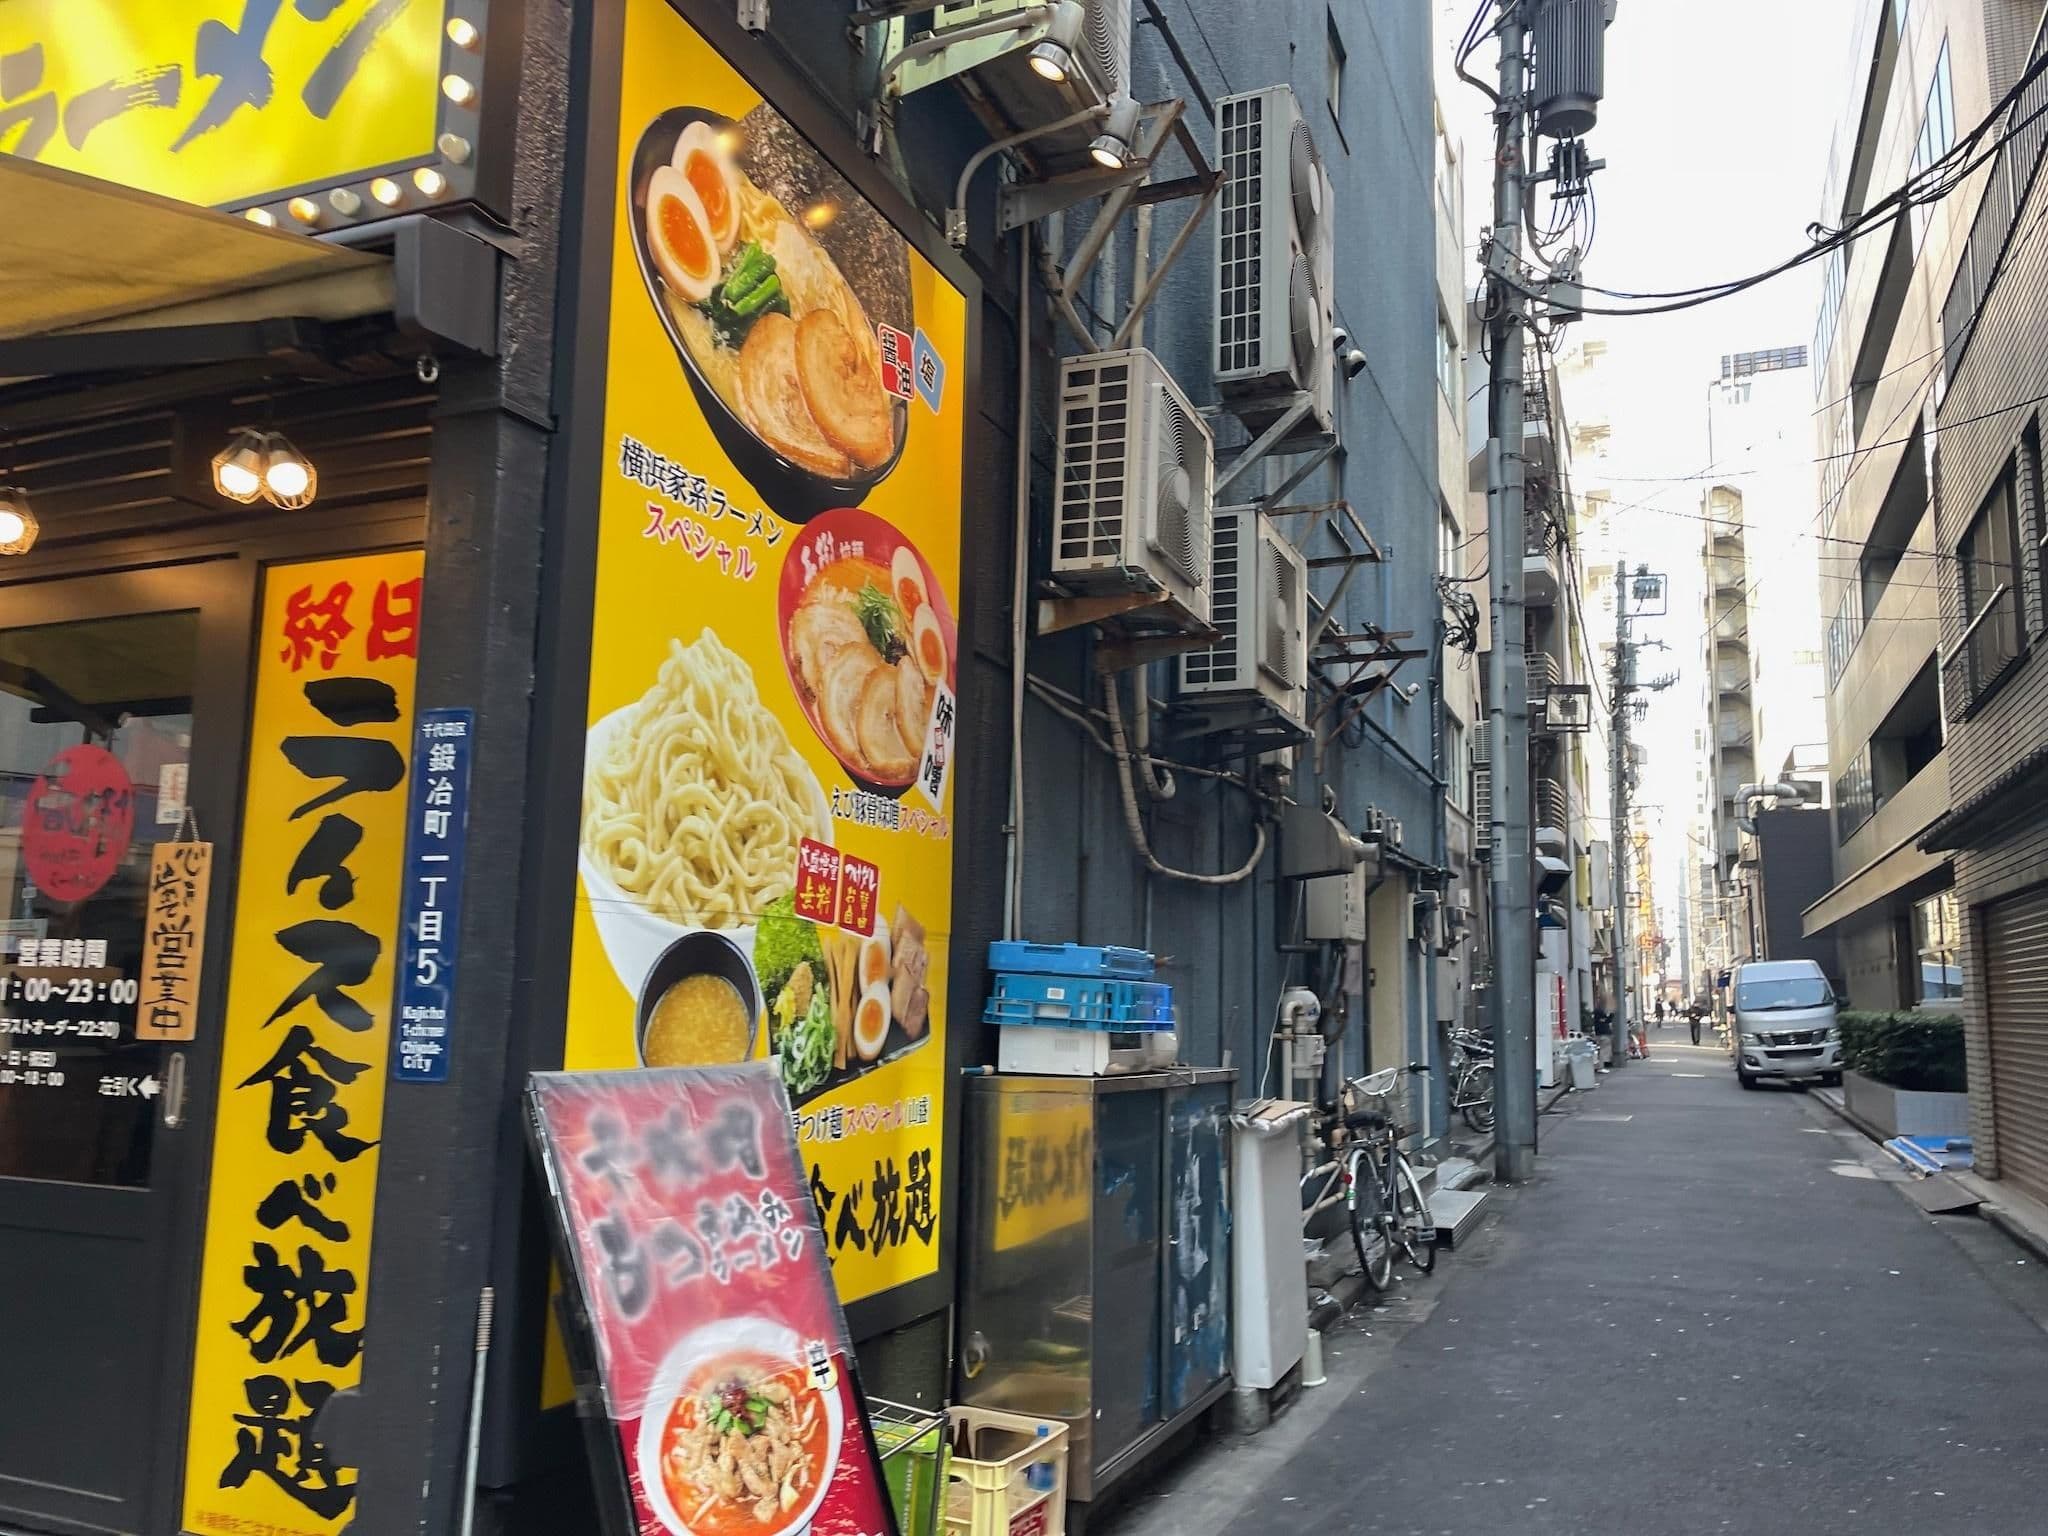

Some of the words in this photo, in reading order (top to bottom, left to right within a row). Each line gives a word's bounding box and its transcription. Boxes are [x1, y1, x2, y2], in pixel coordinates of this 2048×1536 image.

[921, 352, 937, 390] 塩
[619, 435, 784, 545] 横浜家系ラーメン
[644, 503, 756, 580] スペシャル
[402, 1006, 446, 1022] Kajicho
[219, 676, 405, 1521] ライス食べ放題
